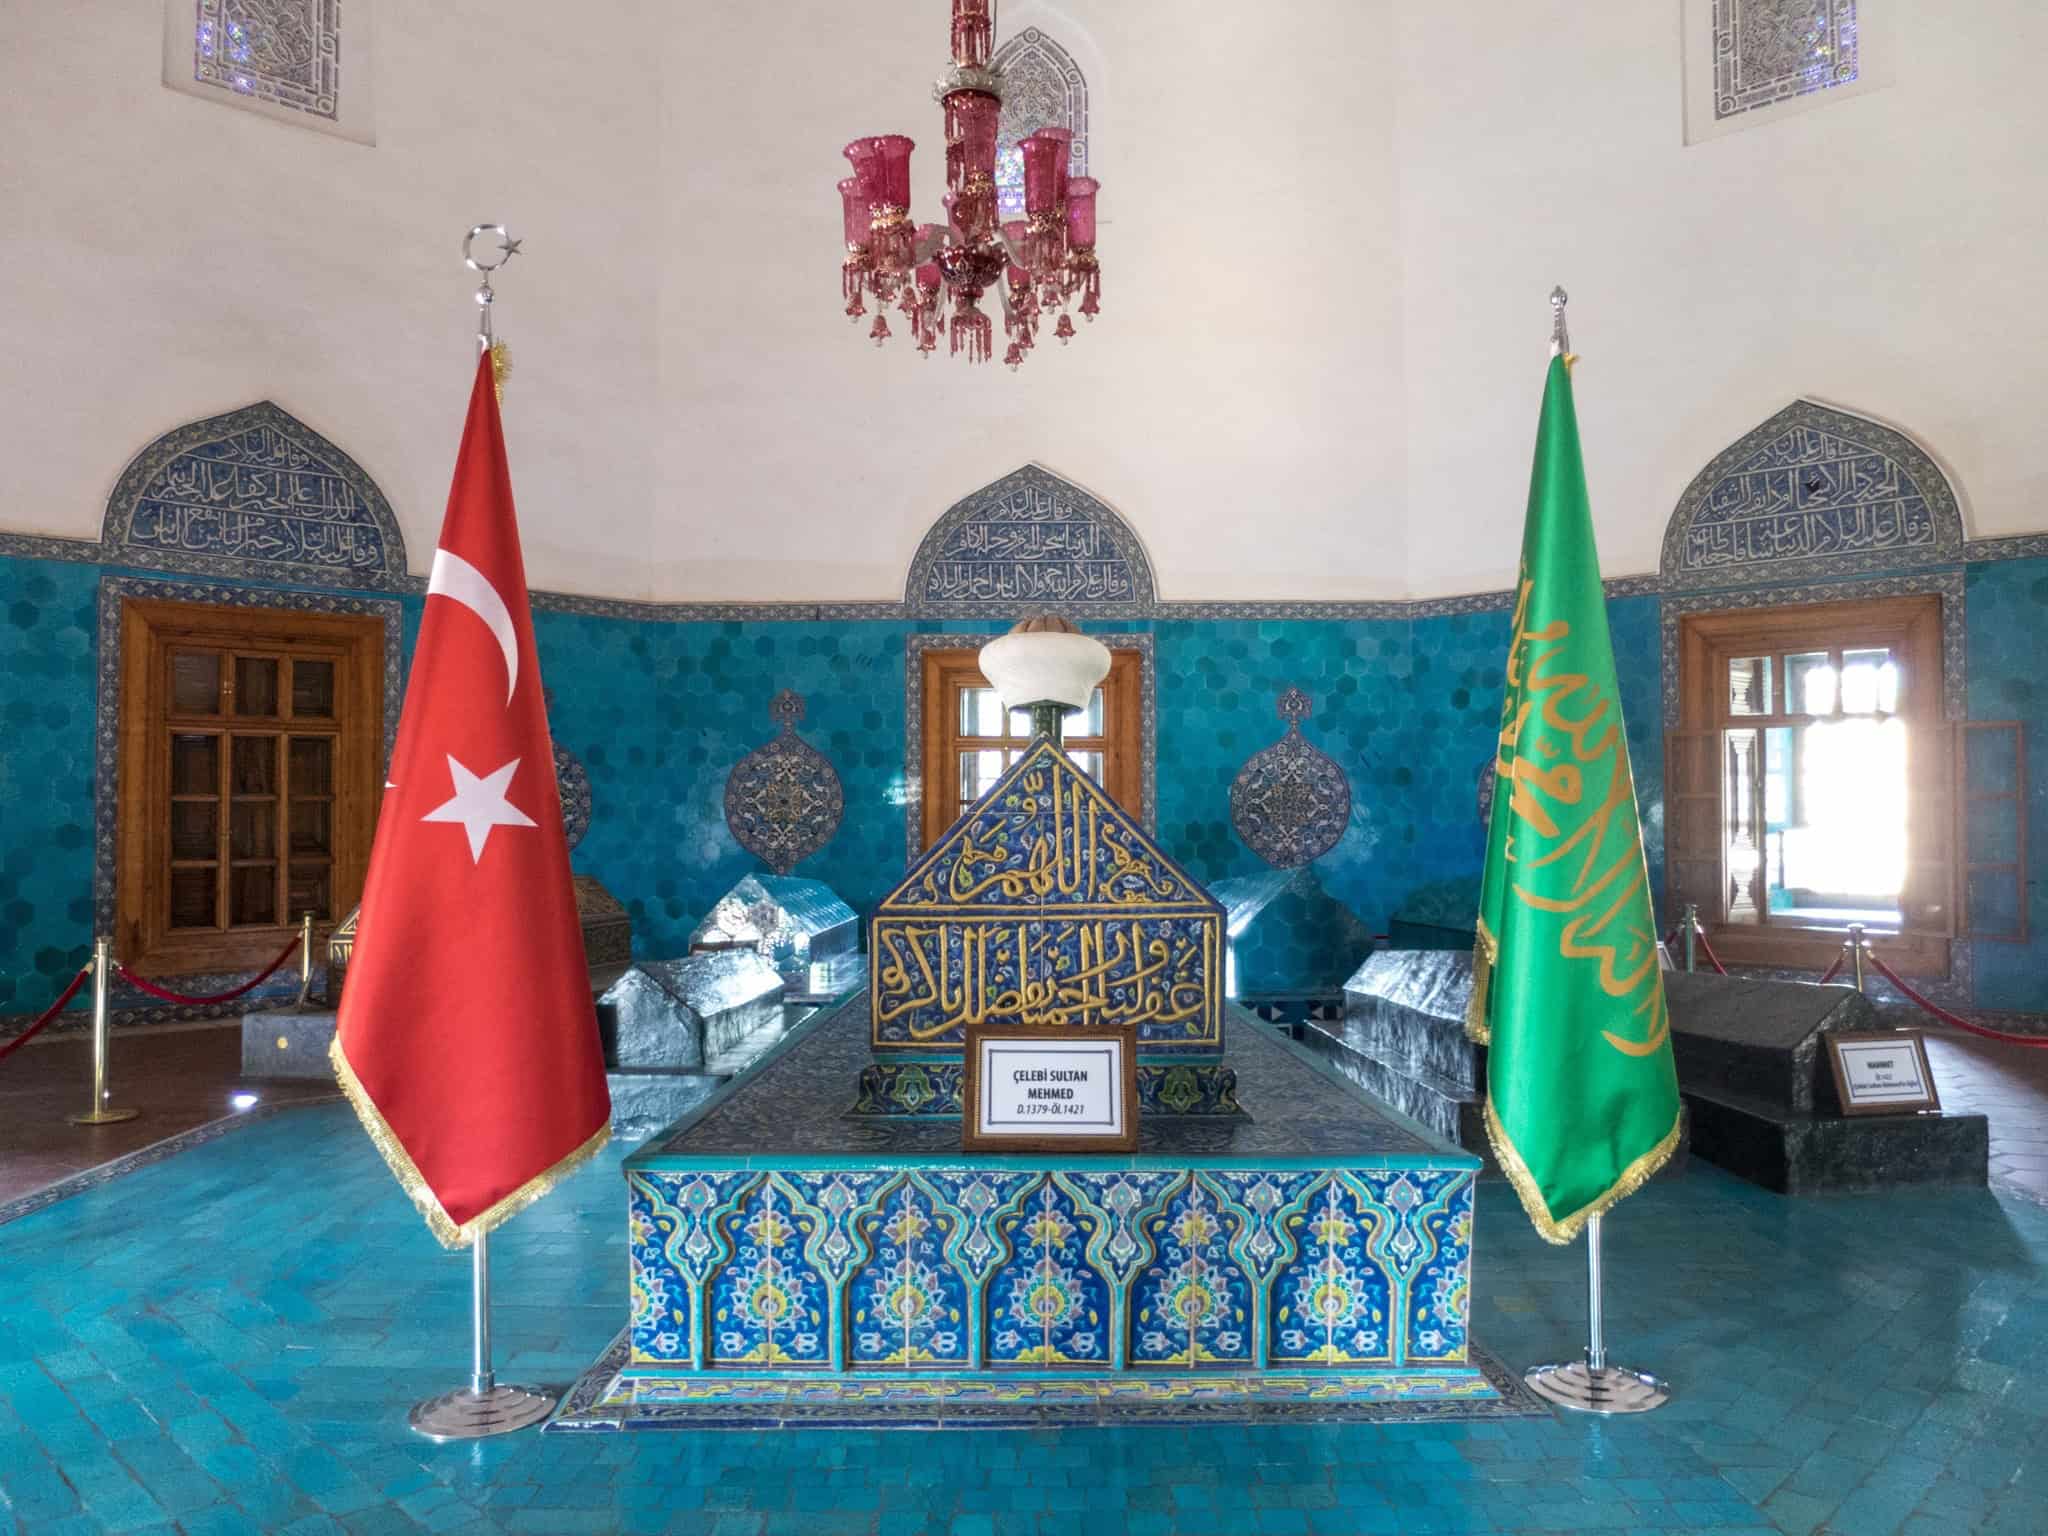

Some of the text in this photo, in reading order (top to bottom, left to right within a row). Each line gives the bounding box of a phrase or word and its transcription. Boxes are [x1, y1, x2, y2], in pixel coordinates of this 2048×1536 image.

[1013, 1068, 1088, 1084] ÇELEBİ SULTAN
[1028, 1088, 1074, 1099] MEHMED
